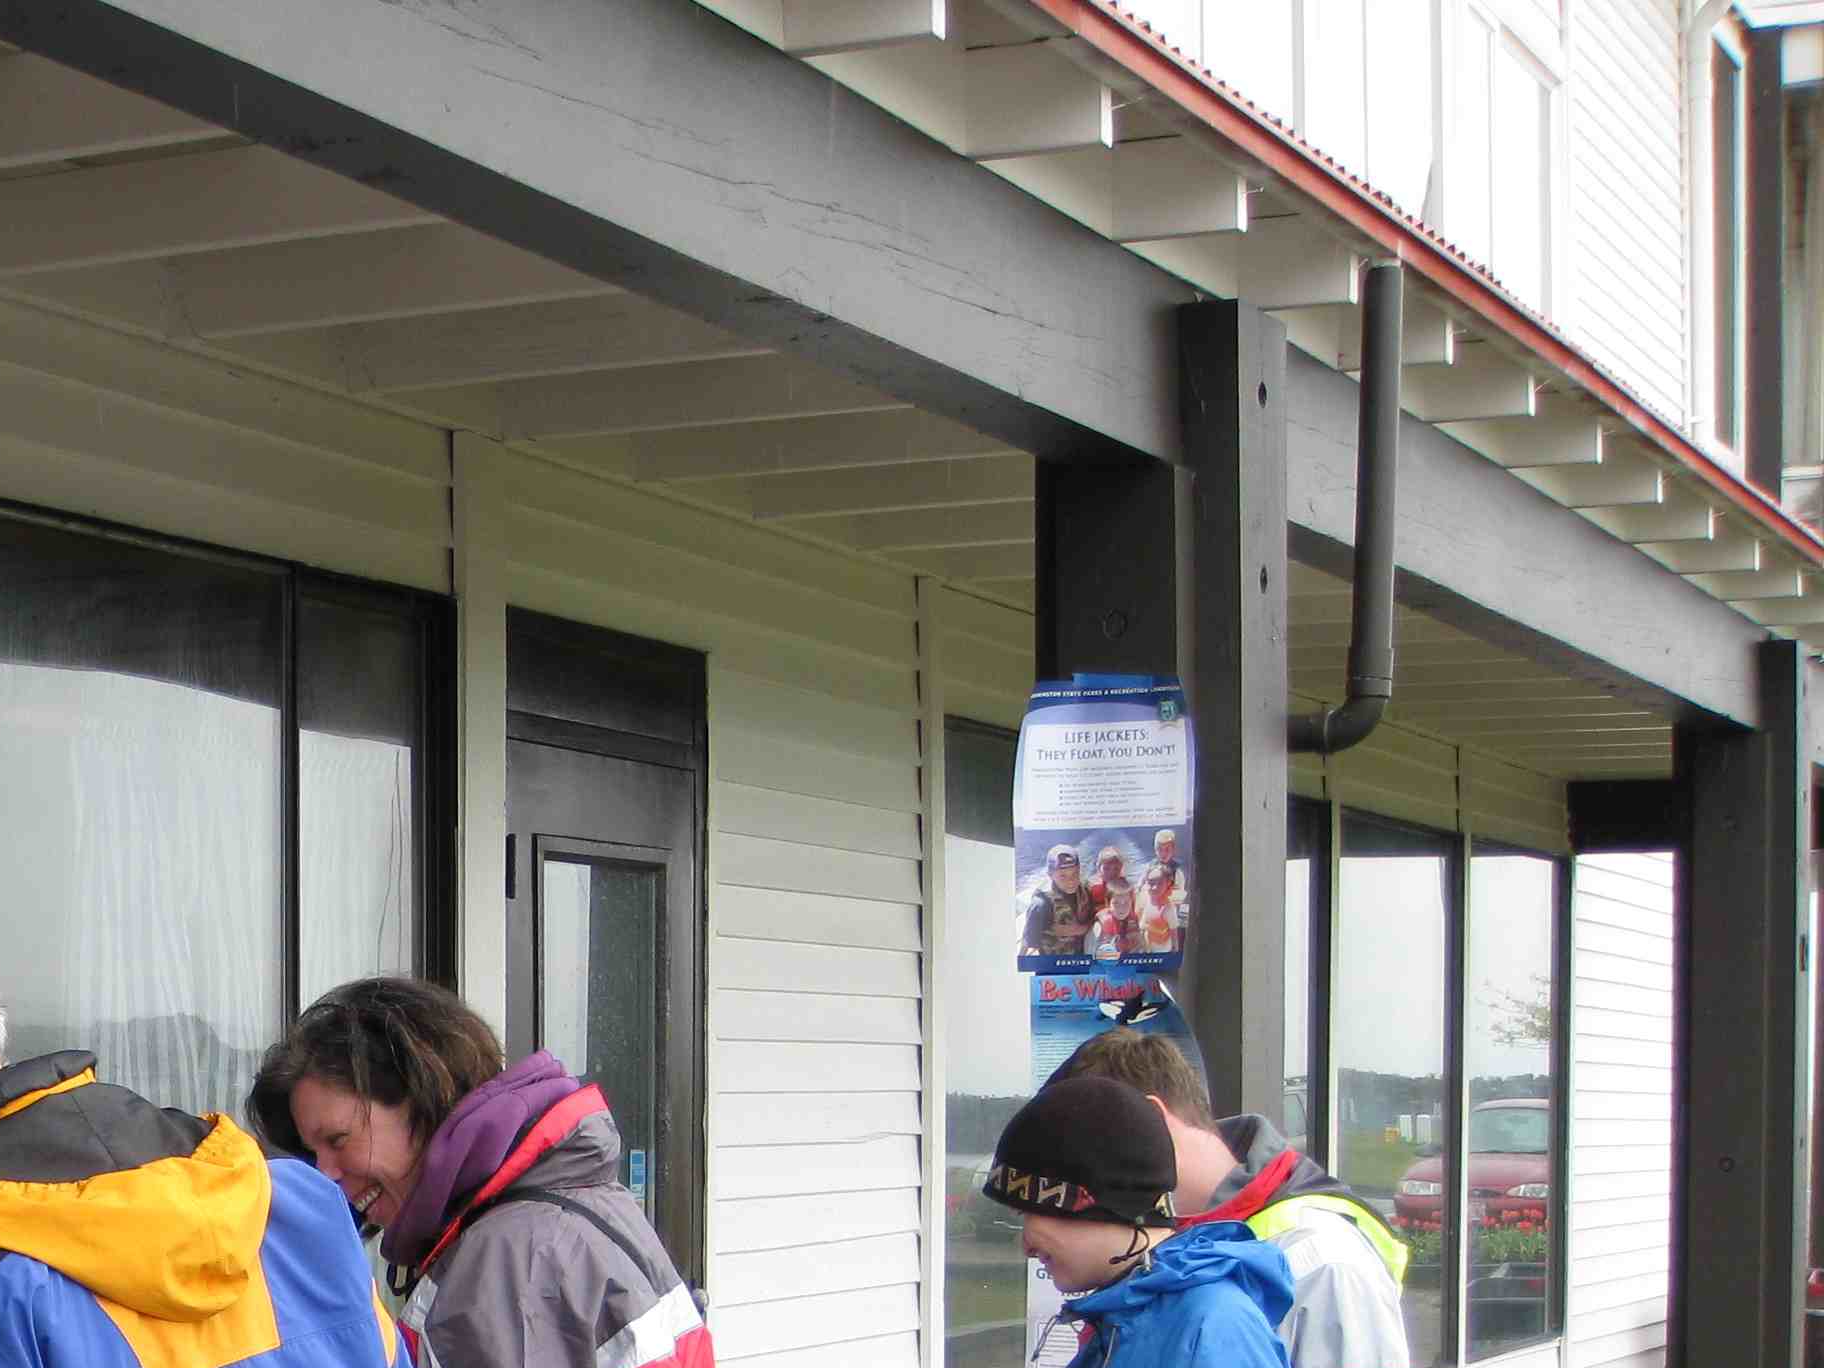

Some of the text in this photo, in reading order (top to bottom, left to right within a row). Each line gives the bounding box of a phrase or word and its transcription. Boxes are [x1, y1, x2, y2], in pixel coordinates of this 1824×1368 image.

[1064, 731, 1091, 745] LIFE
[1037, 749, 1066, 761] THEY
[1108, 746, 1133, 758] YOU
[1039, 978, 1072, 1002] Be
